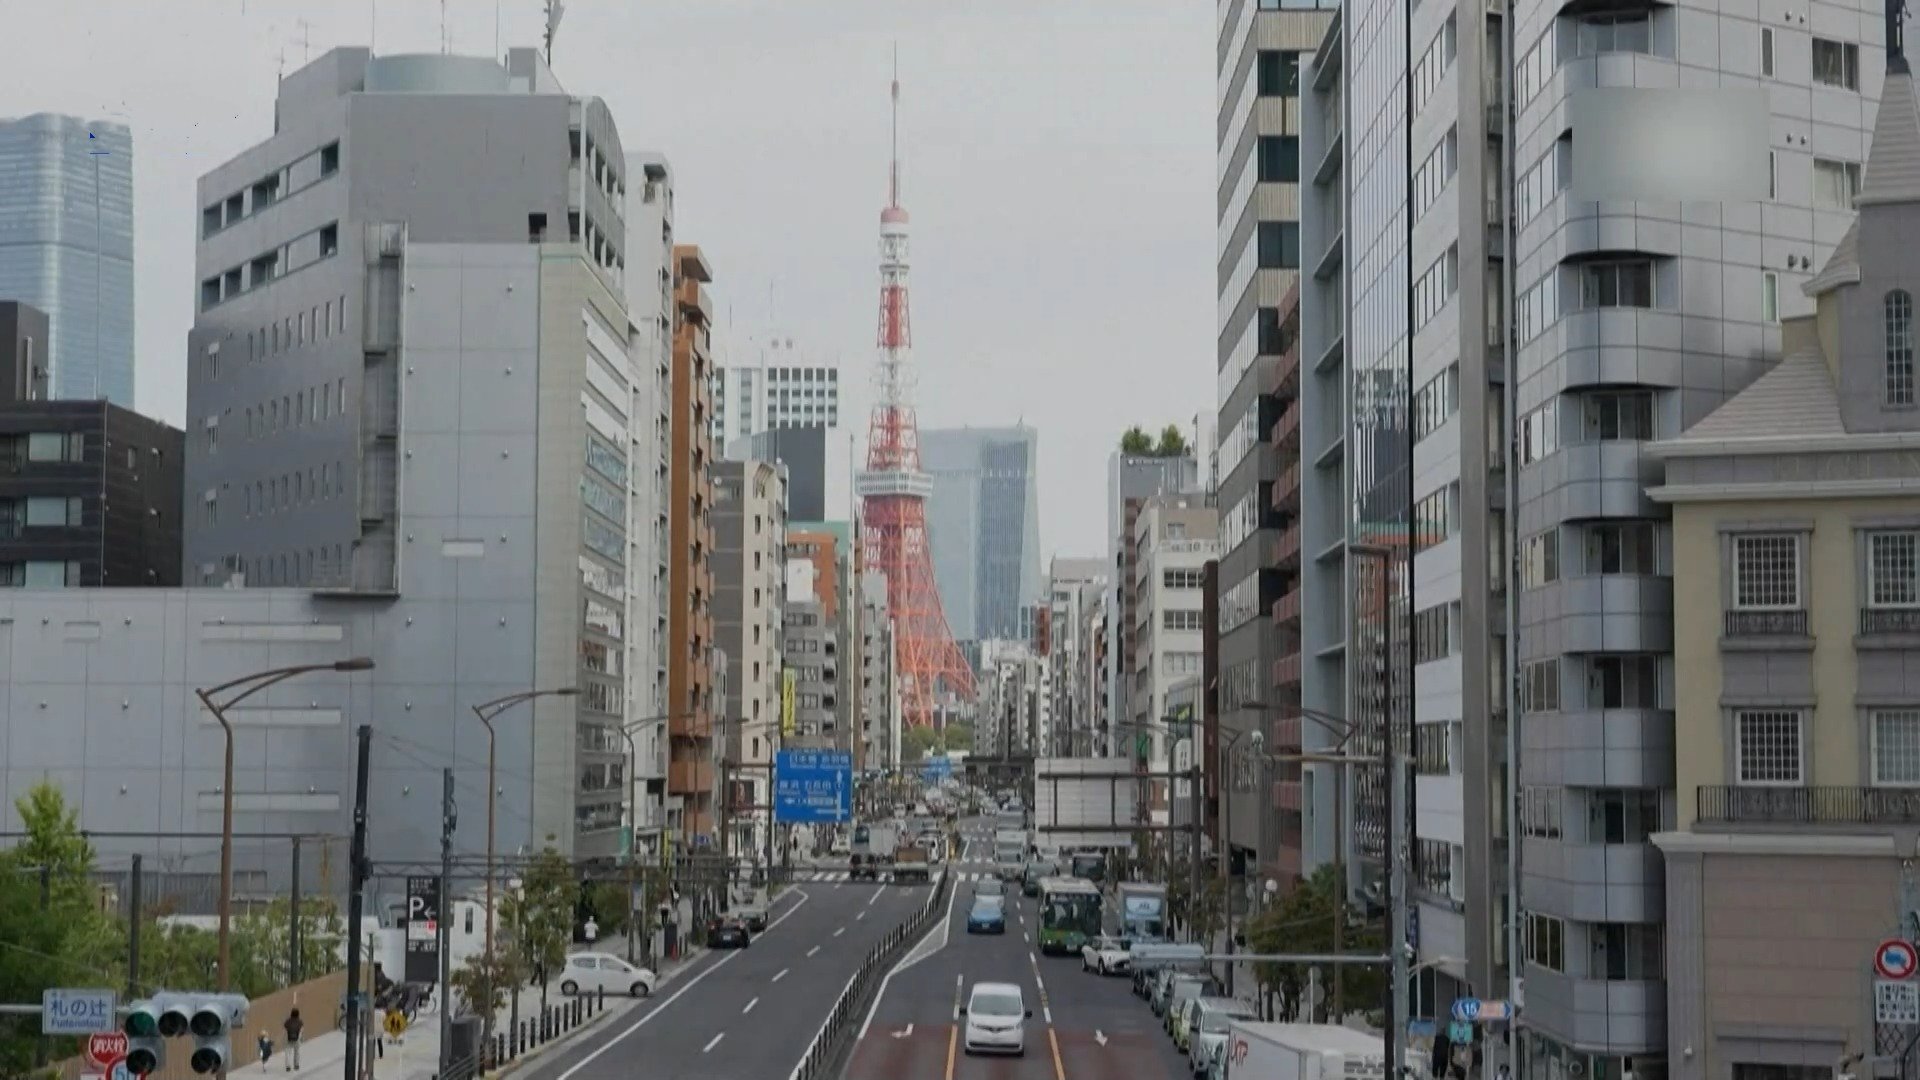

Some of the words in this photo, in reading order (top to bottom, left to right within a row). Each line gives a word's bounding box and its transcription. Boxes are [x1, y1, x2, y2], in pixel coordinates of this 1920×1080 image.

[409, 896, 424, 920] P
[51, 999, 107, 1017] 札の辻
